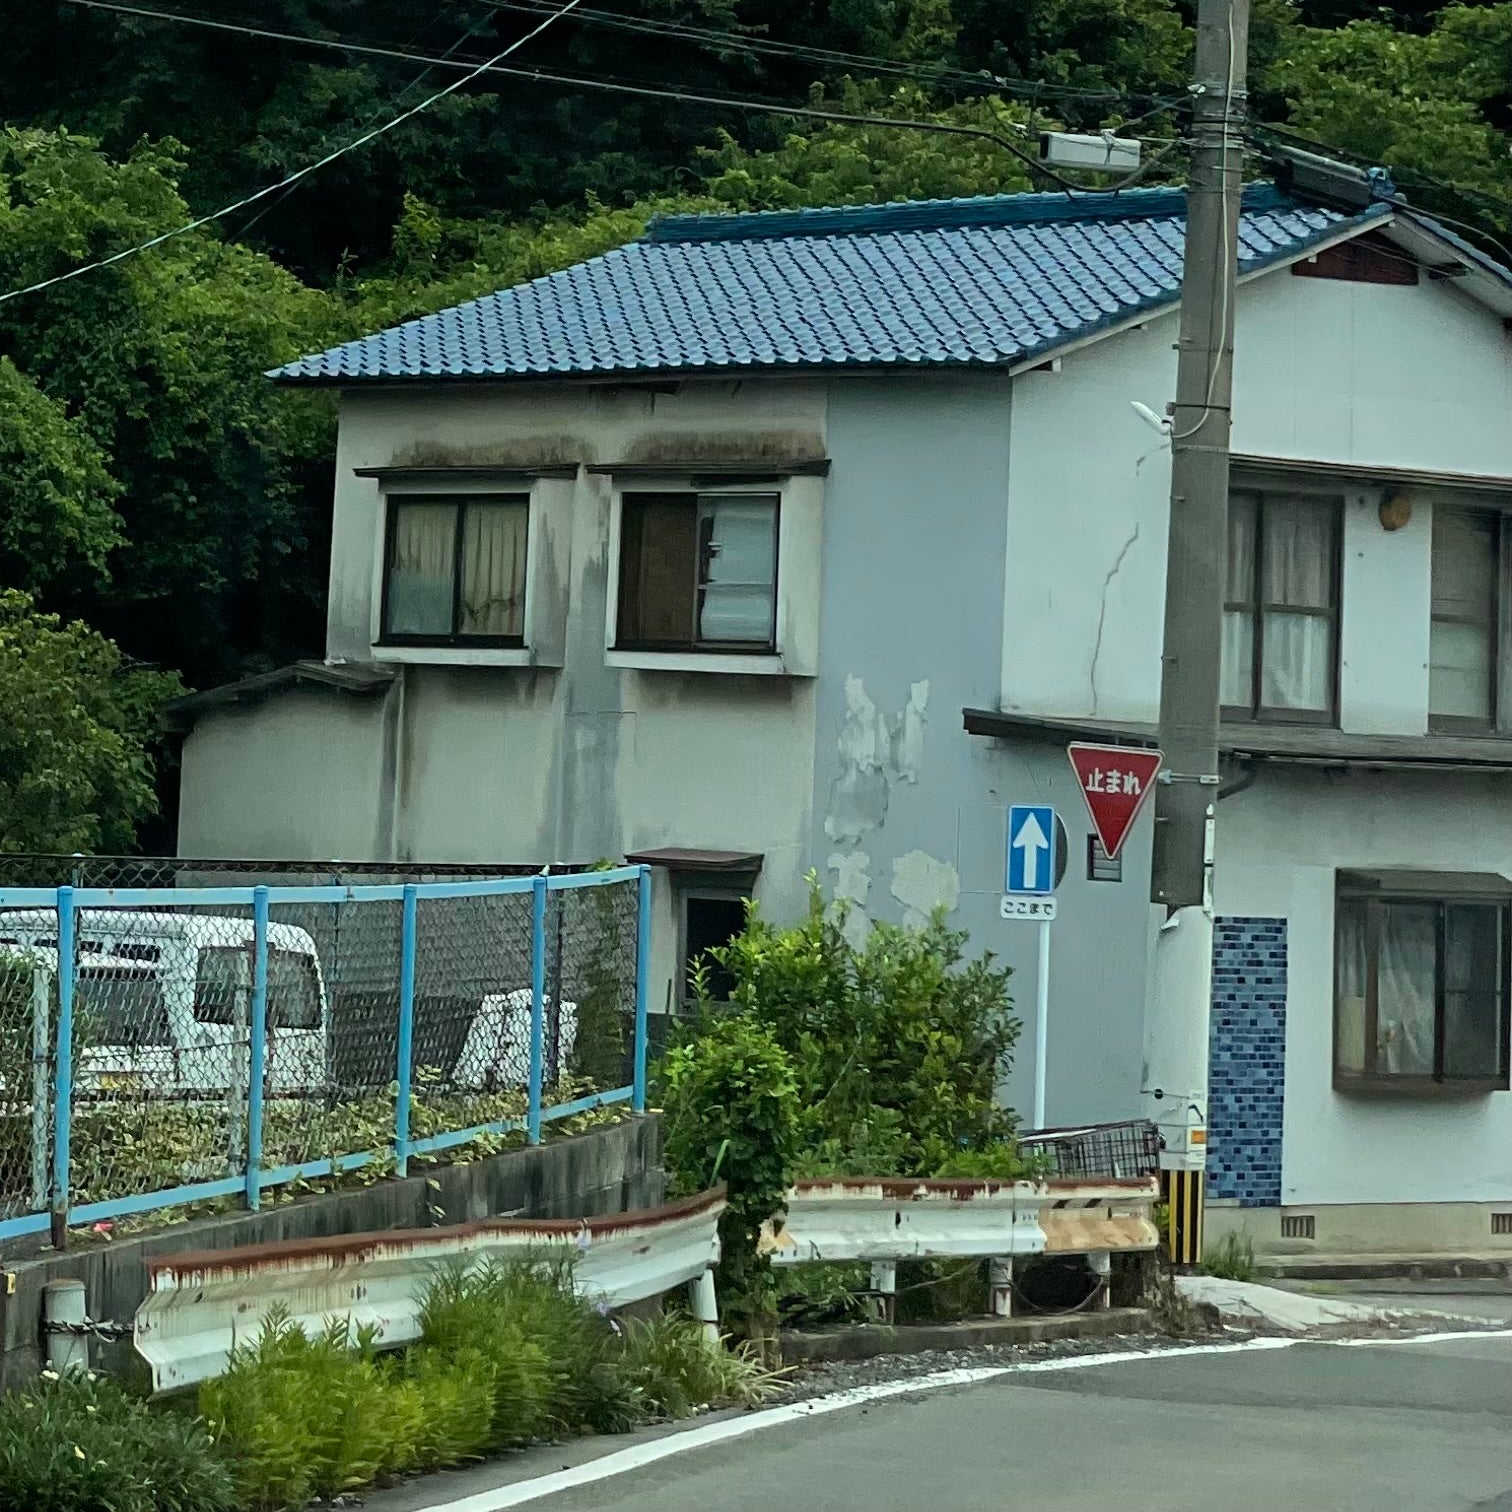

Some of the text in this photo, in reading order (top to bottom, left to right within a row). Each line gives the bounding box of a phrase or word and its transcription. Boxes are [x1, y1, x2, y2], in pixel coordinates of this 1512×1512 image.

[1086, 768, 1141, 795] 止まれ
[1004, 901, 1053, 915] ここまで
